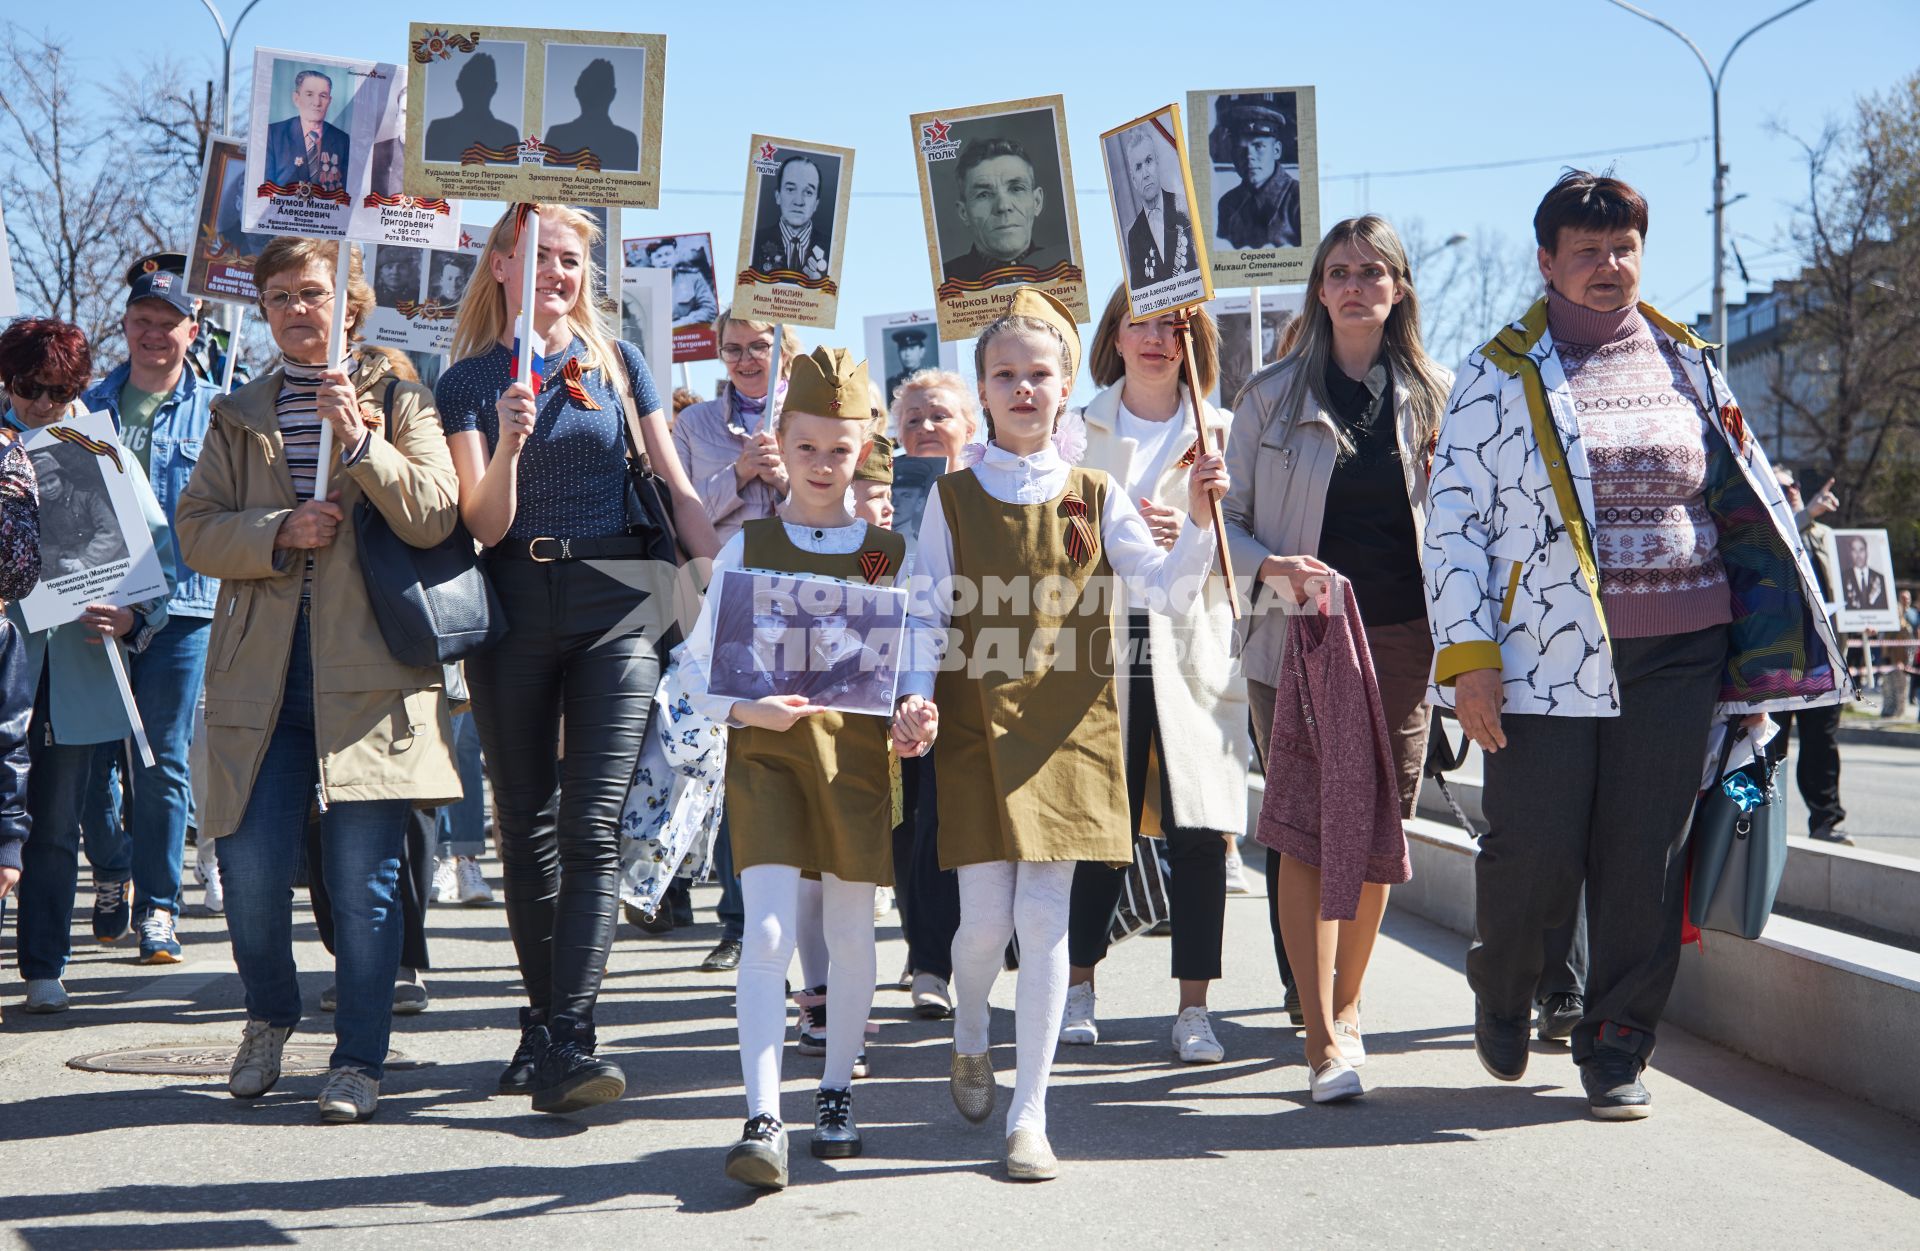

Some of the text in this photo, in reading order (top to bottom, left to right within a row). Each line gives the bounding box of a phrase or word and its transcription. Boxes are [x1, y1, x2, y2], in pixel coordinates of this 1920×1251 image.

[928, 150, 955, 160] ПОЛК
[756, 166, 775, 174] ПОЛК
[575, 176, 603, 184] Андрей
[605, 178, 651, 186] Степанович
[270, 197, 339, 211] Наумов Михаил
[278, 206, 330, 219] Алексеевич
[381, 207, 434, 221] Хмелев Петр
[381, 217, 433, 229] Григорьевич
[1240, 252, 1276, 261] Сергеев
[1249, 261, 1303, 269] Степанович
[772, 288, 802, 298] МИКЛИН
[1150, 284, 1176, 297] Александр
[754, 294, 818, 308] Иван Михайлович
[1172, 290, 1198, 302] машинист
[947, 297, 988, 309] Чирков
[991, 294, 1013, 304] Ива
[770, 304, 800, 313] Лейтенант
[752, 309, 796, 319] Ленинградский
[379, 327, 407, 336] Виталий
[413, 322, 438, 331] Братья
[376, 335, 408, 344] Иванович
[677, 341, 711, 349] Петрович
[47, 561, 130, 590] Новожилова (Маймусова)
[57, 572, 125, 595] Зинаида Николаевна
[83, 586, 104, 596] Снайпер
